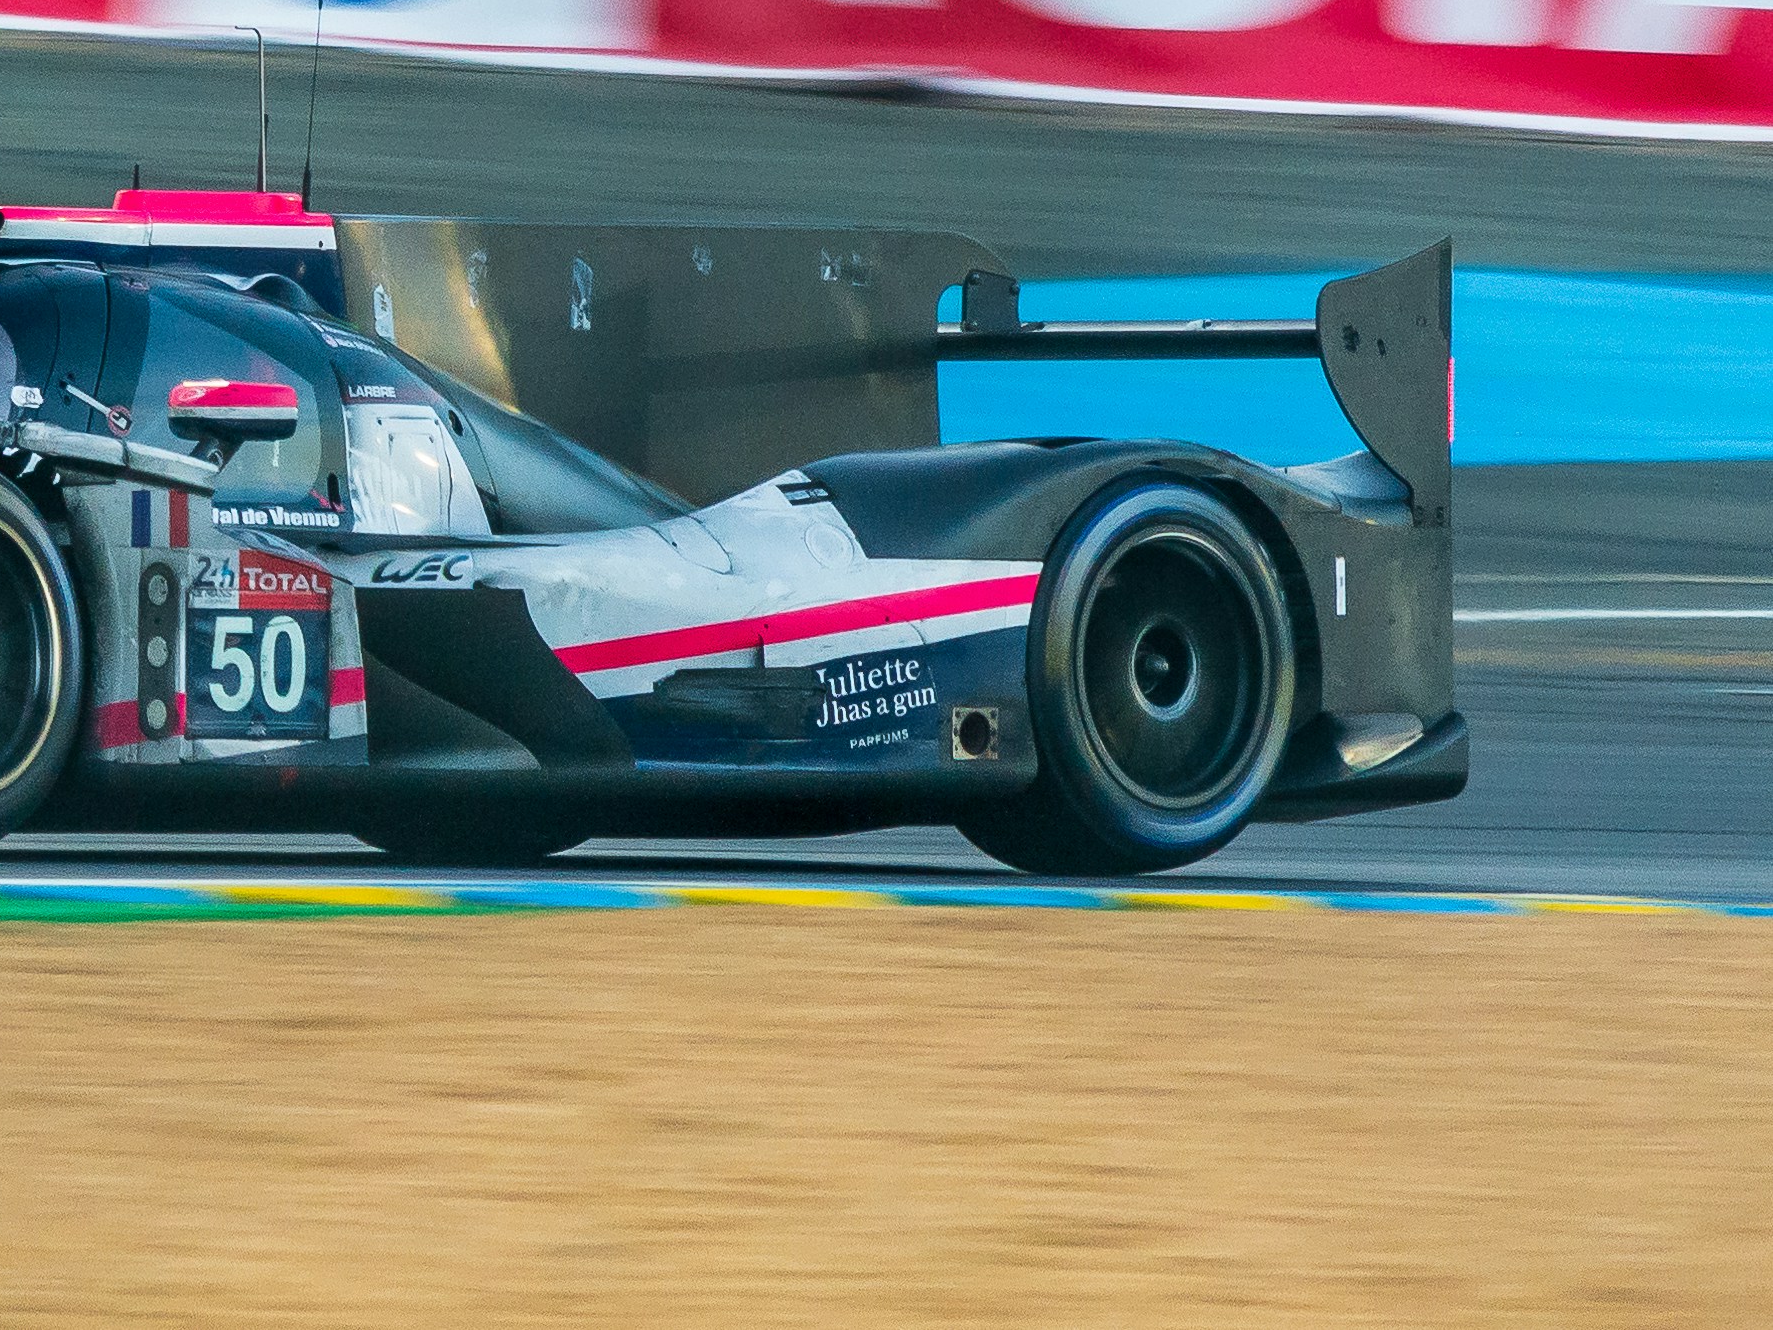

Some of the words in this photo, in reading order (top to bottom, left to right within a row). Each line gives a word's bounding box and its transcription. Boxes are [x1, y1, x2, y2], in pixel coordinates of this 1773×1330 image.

[348, 385, 396, 398] LARBRE
[241, 508, 268, 525] de
[269, 506, 341, 528] Vienne
[243, 567, 328, 595] TOTAL
[371, 553, 470, 583] WEC
[208, 615, 306, 713] 50
[893, 686, 937, 717] gun
[849, 728, 909, 749] PARFUMS
